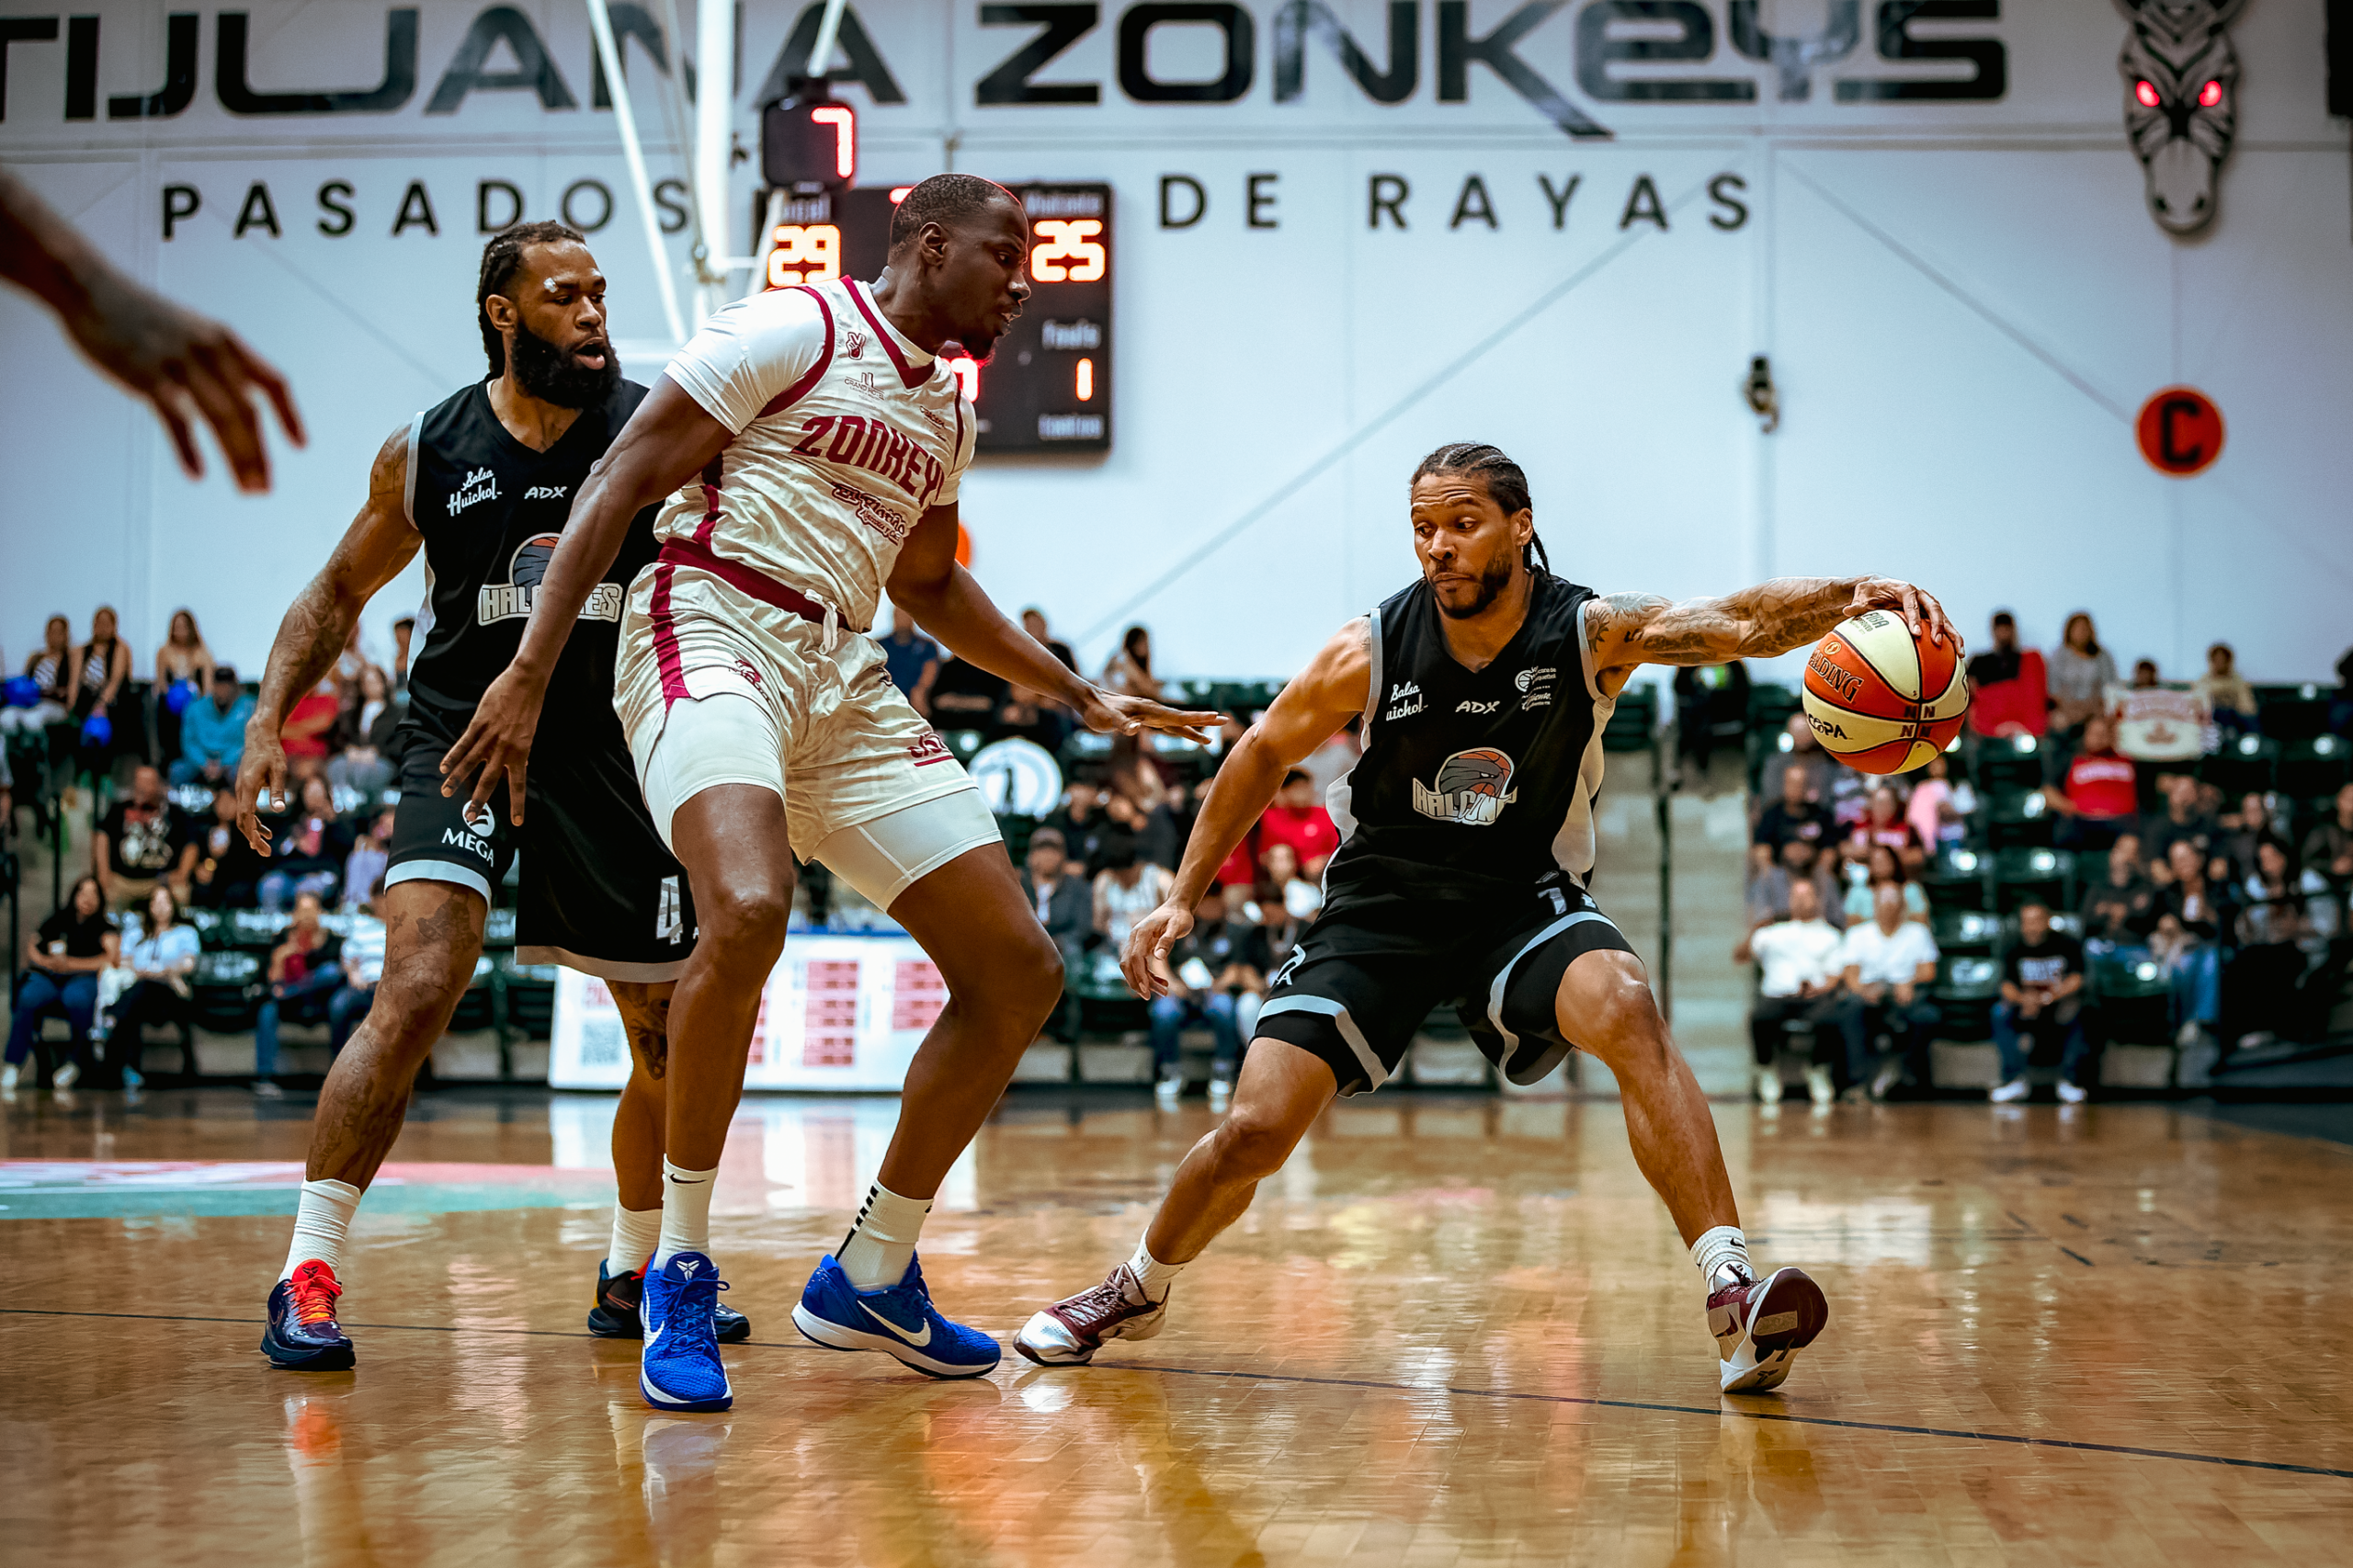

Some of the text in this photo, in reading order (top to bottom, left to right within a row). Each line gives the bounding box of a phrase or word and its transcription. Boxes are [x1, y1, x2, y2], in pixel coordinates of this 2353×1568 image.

[812, 107, 853, 178] 7
[162, 172, 1750, 239] PASADOS DE RAYAS
[767, 224, 842, 288] 29
[1030, 220, 1106, 283] 25
[1075, 358, 1094, 402] 1
[2161, 400, 2201, 465] C
[460, 467, 494, 491] Salsa
[790, 415, 945, 508] ZONKEY
[524, 486, 567, 499] ADX
[482, 586, 618, 622] HALES
[1385, 693, 1423, 722] uichol
[1390, 681, 1420, 703] Salsa
[1455, 700, 1500, 714] ADX
[1415, 781, 1517, 823] HALCON
[441, 827, 494, 868] MEGA
[656, 875, 683, 945] 4
